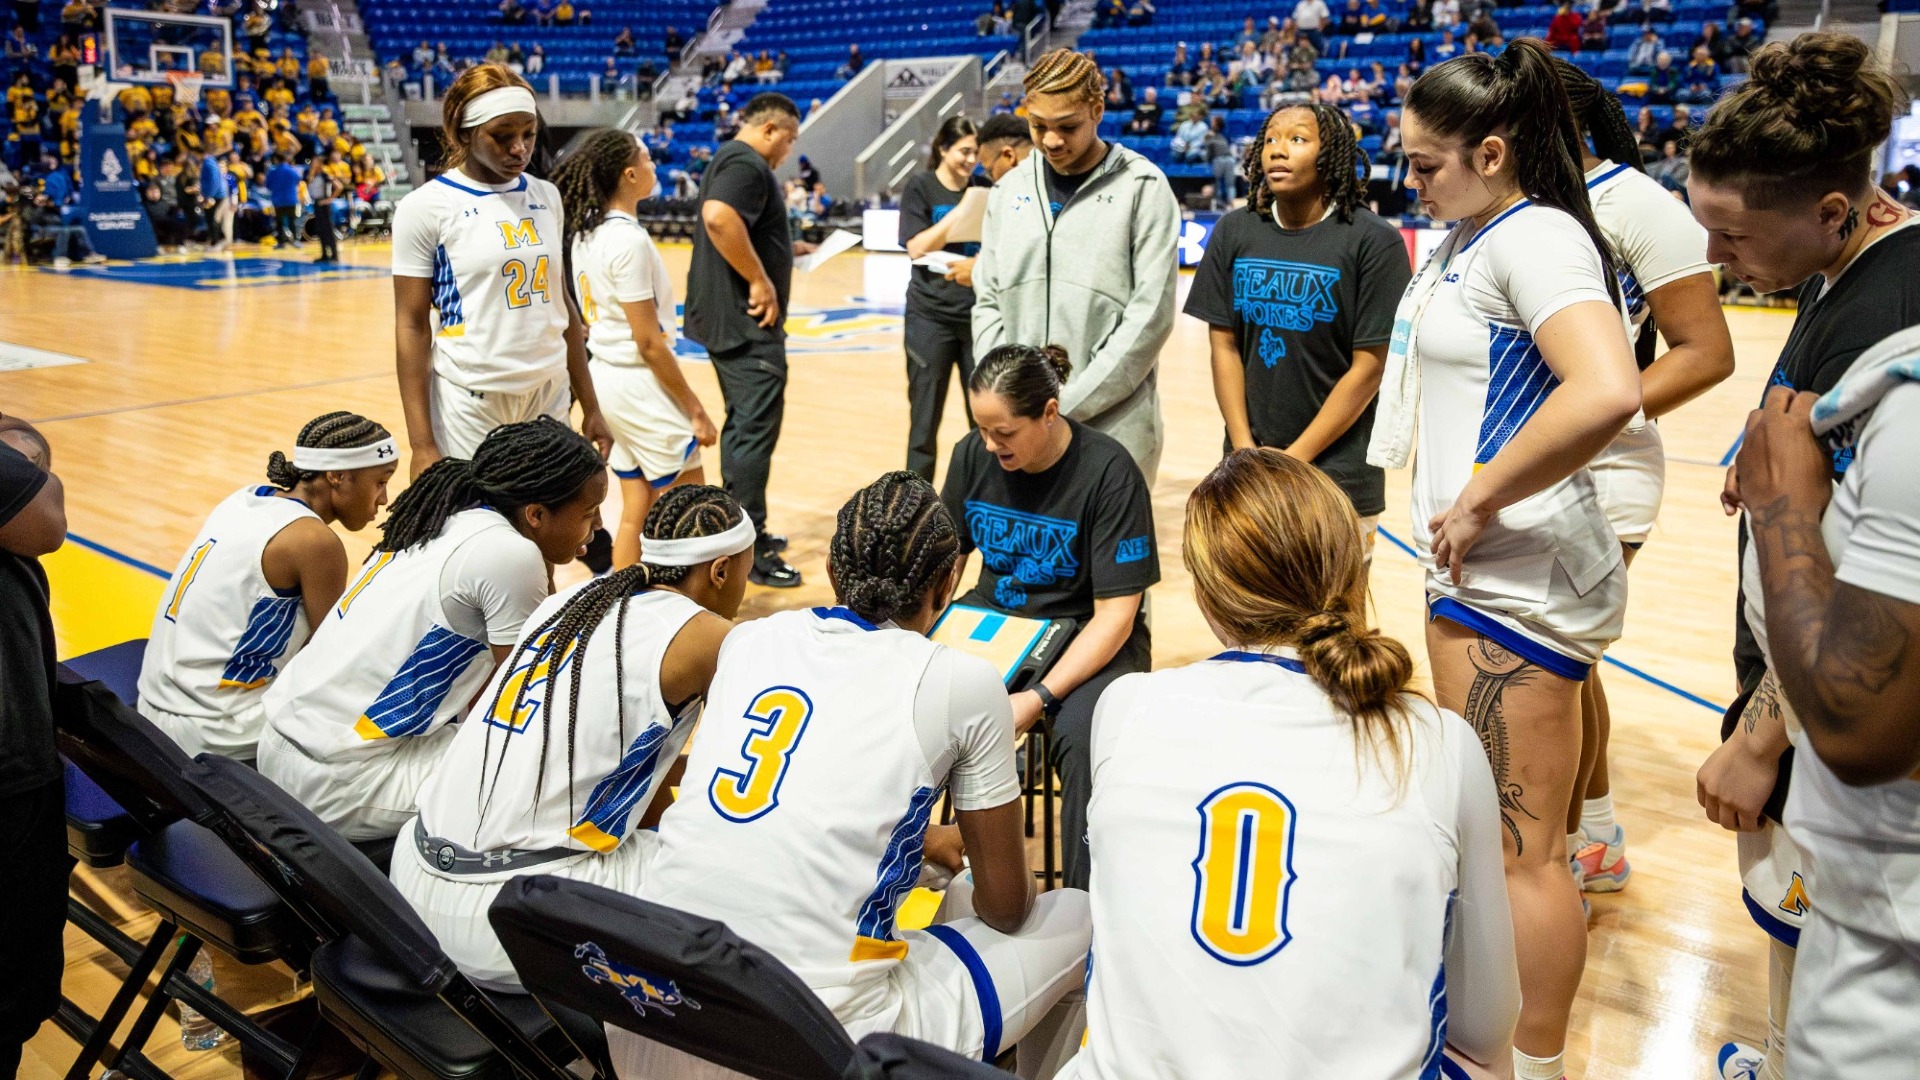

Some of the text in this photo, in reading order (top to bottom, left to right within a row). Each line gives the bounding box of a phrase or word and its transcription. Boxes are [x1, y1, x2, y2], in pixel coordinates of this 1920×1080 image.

[496, 217, 543, 250] M
[501, 255, 550, 309] 24
[1242, 301, 1314, 331] POKES
[965, 507, 1080, 568] GEAUX
[164, 537, 218, 625] 1
[482, 626, 582, 735] 2
[708, 685, 814, 824] 3
[1191, 781, 1298, 967] 0
